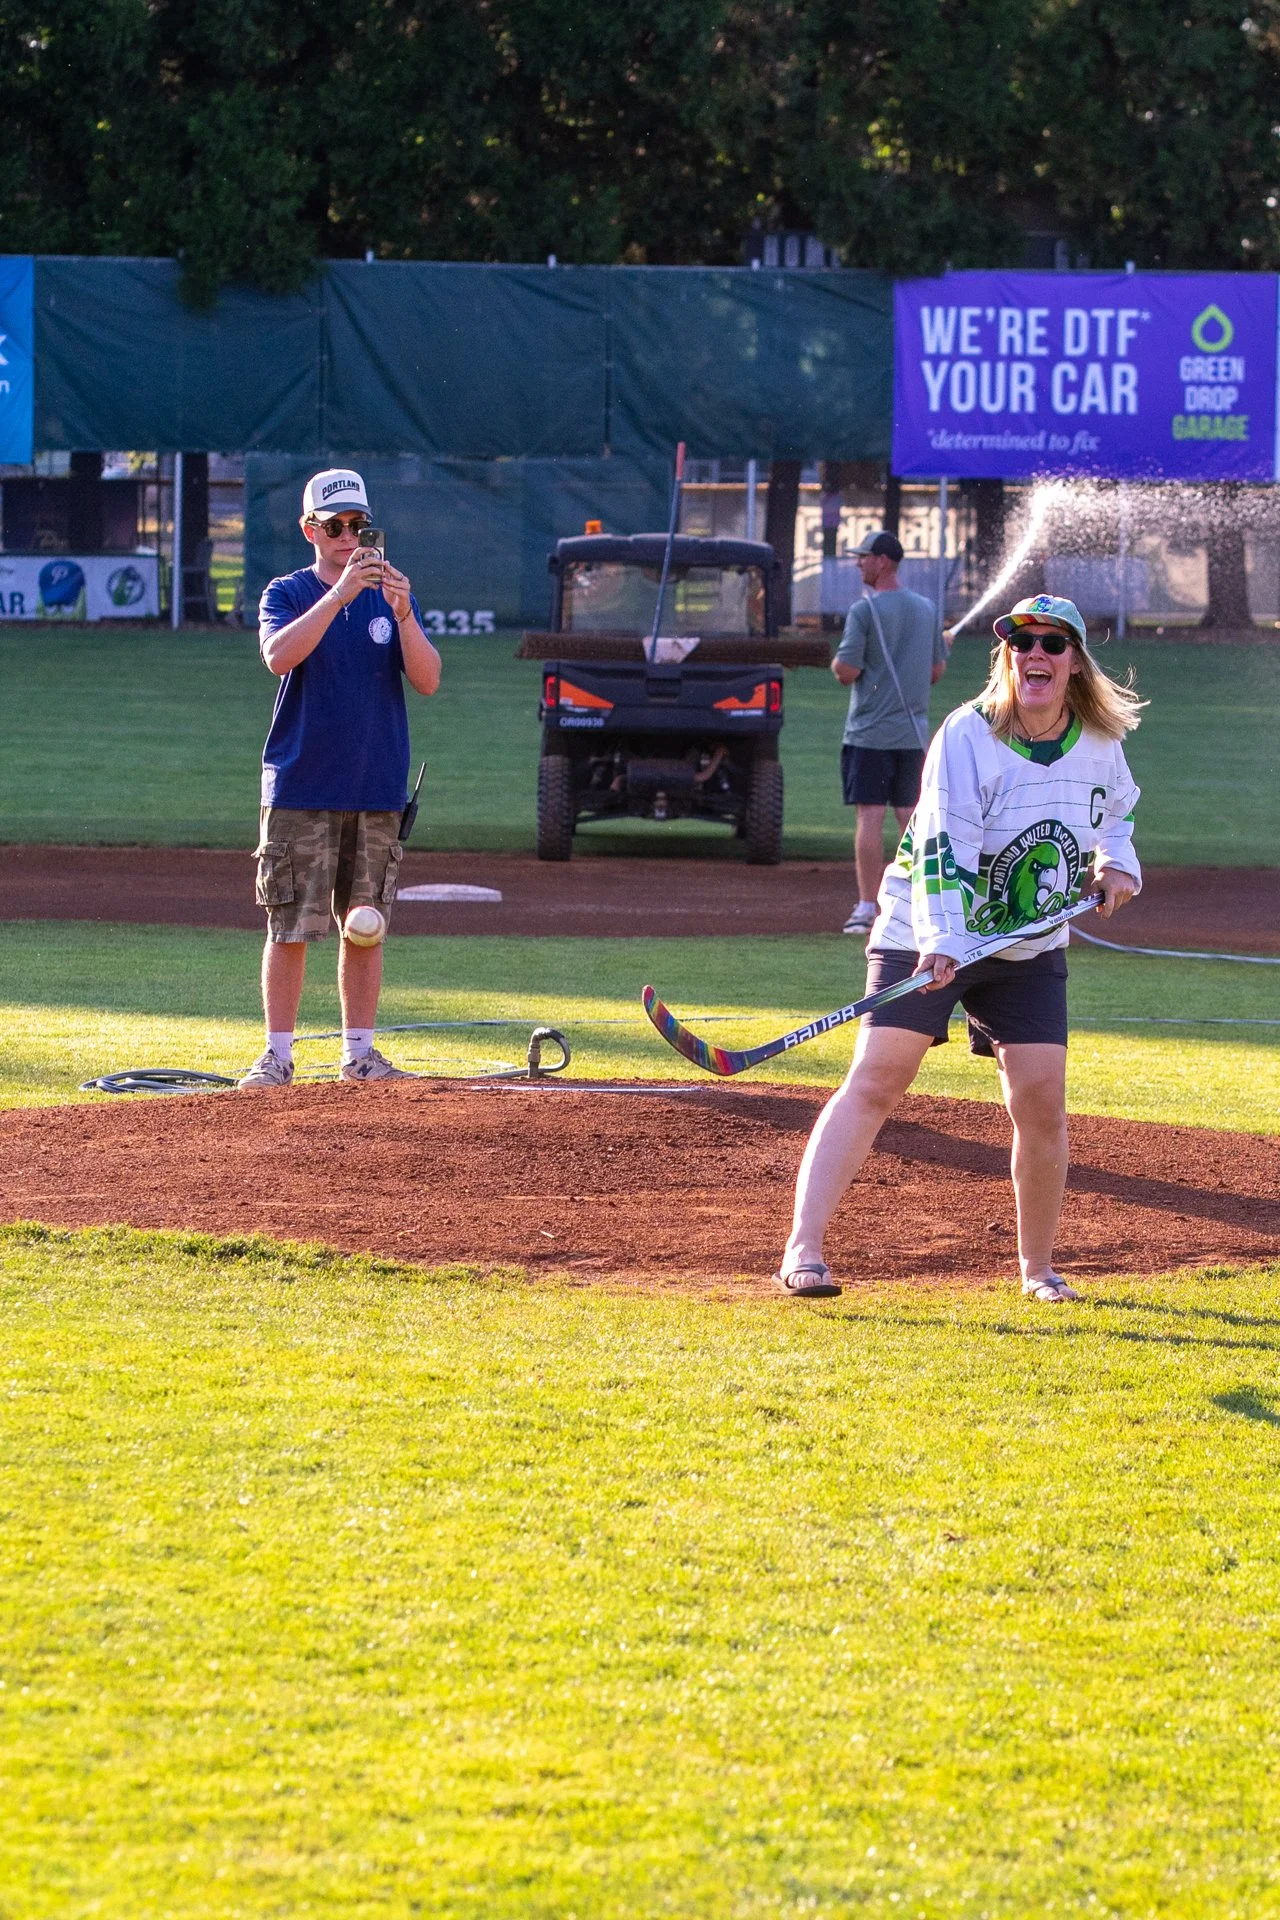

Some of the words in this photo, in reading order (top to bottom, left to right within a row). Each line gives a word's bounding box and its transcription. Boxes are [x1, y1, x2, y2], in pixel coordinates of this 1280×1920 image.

[1179, 356, 1245, 382] GREEN
[921, 360, 1037, 413] YOUR
[1051, 362, 1139, 415] CAR
[1184, 385, 1239, 412] DROP
[1172, 414, 1249, 441] GARAGE
[1048, 432, 1071, 450] to
[1068, 429, 1100, 456] fix
[322, 480, 360, 497] PORTLAND
[424, 609, 495, 634] 335
[1090, 786, 1107, 829] C
[993, 845, 1021, 892] PORTLAND
[1019, 823, 1051, 849] UNITED
[1053, 825, 1077, 859] HCKEY
[961, 950, 984, 964] LITE
